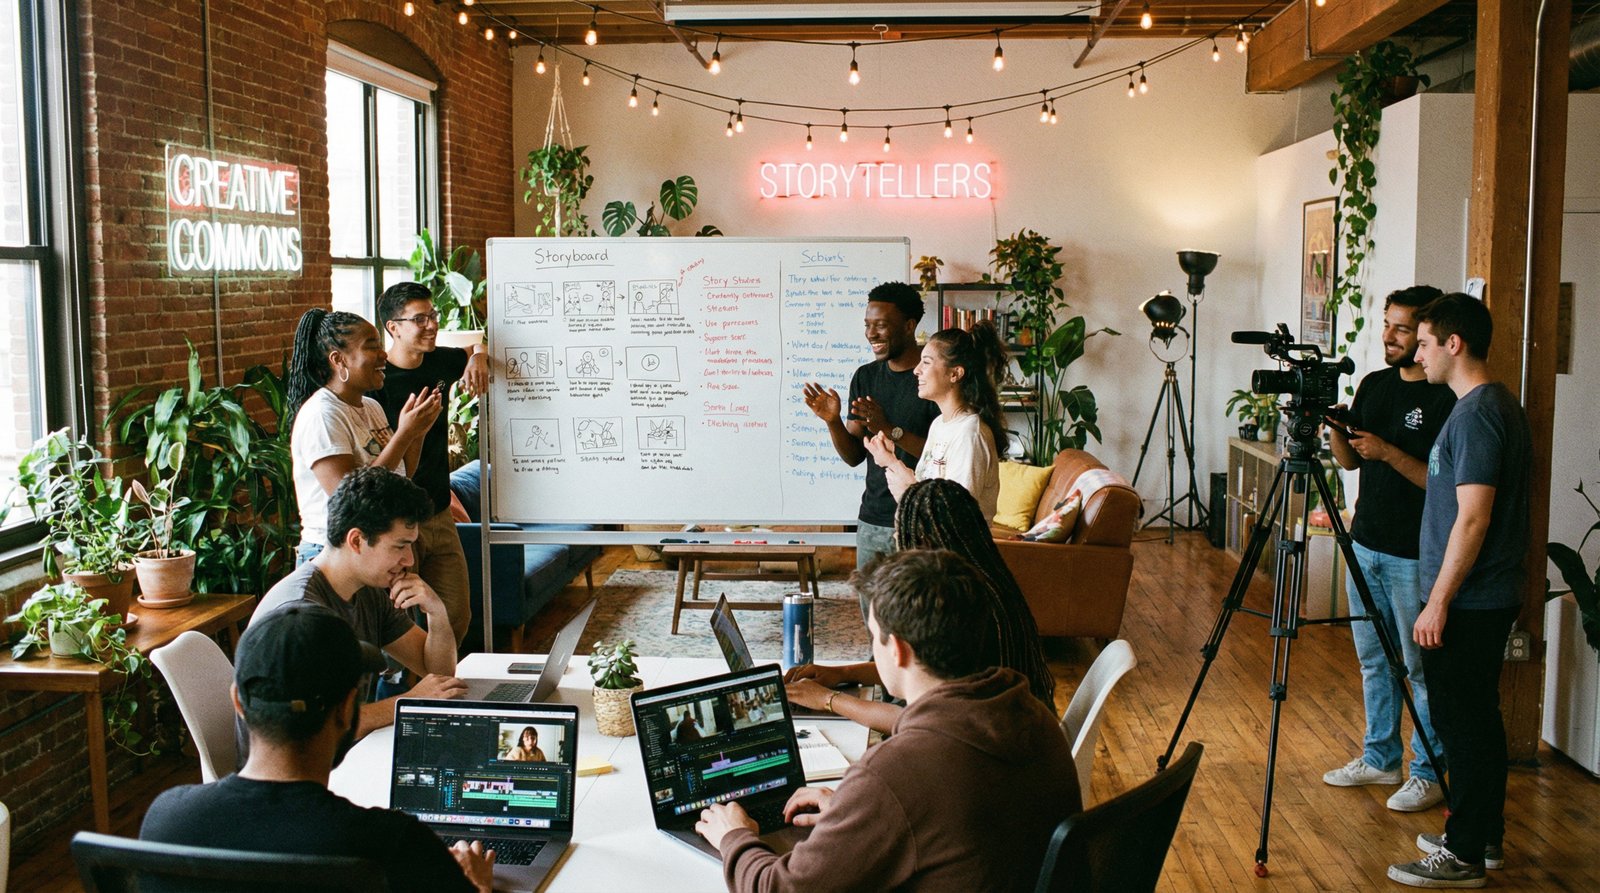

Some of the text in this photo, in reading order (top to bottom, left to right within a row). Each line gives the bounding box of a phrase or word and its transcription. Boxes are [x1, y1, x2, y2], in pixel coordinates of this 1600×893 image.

[170, 153, 296, 215] CREATIVE
[760, 162, 991, 199] STORYTELLERS
[169, 218, 302, 271] COMMONS
[534, 248, 609, 268] Storyboard
[703, 276, 728, 288] Story
